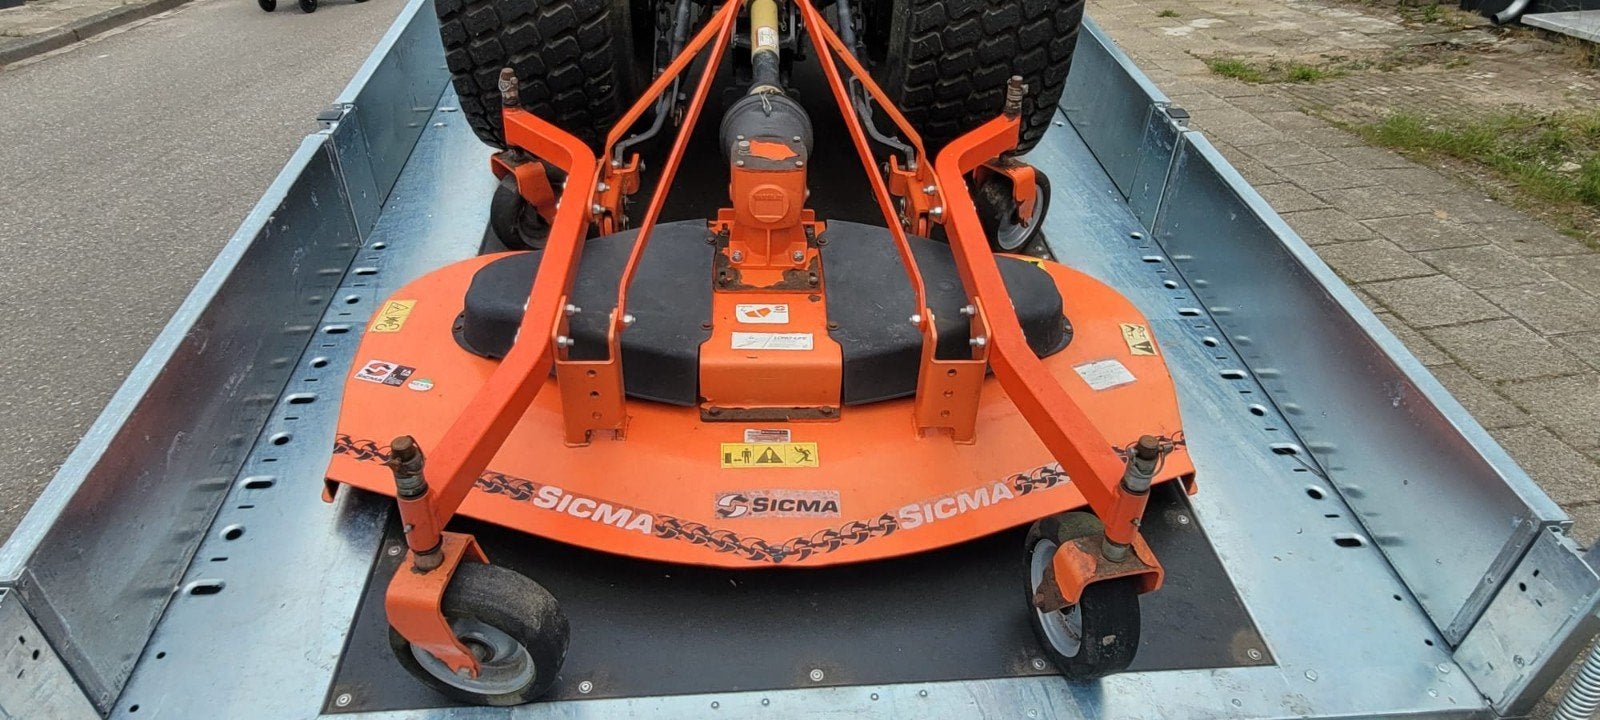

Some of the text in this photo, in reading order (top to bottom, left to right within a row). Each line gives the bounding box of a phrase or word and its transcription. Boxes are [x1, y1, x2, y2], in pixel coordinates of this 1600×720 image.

[533, 485, 653, 534] SICMA
[752, 497, 838, 513] SICMA
[898, 482, 1015, 530] SICMA
